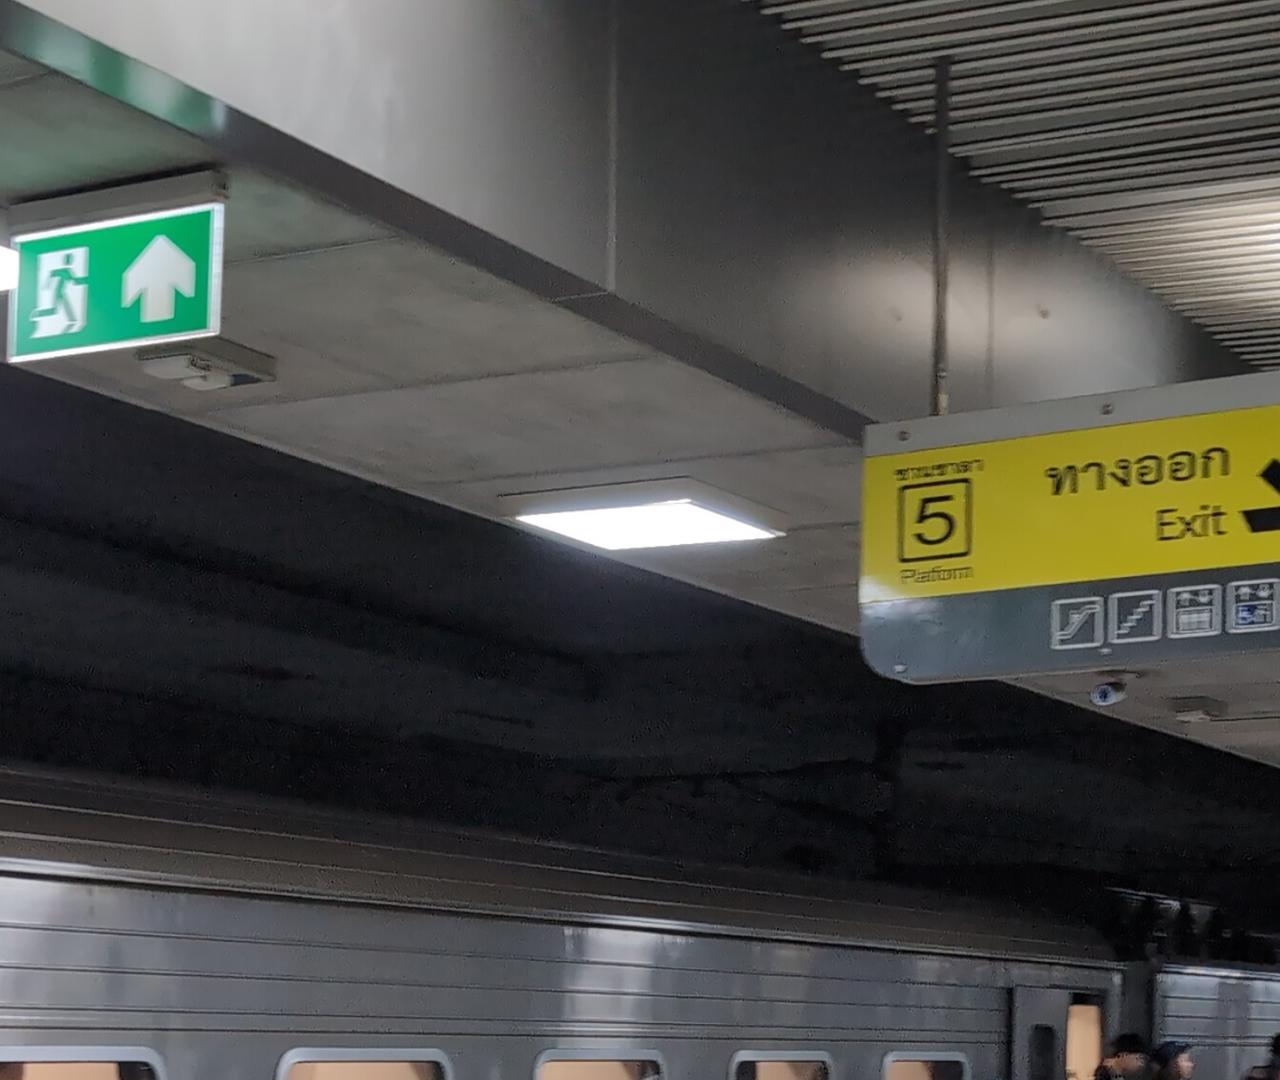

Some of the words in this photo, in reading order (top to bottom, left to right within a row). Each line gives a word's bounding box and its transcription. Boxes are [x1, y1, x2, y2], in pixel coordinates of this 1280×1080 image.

[1044, 446, 1231, 496] ทางออก
[913, 494, 956, 546] 5
[1155, 504, 1228, 541] Exit
